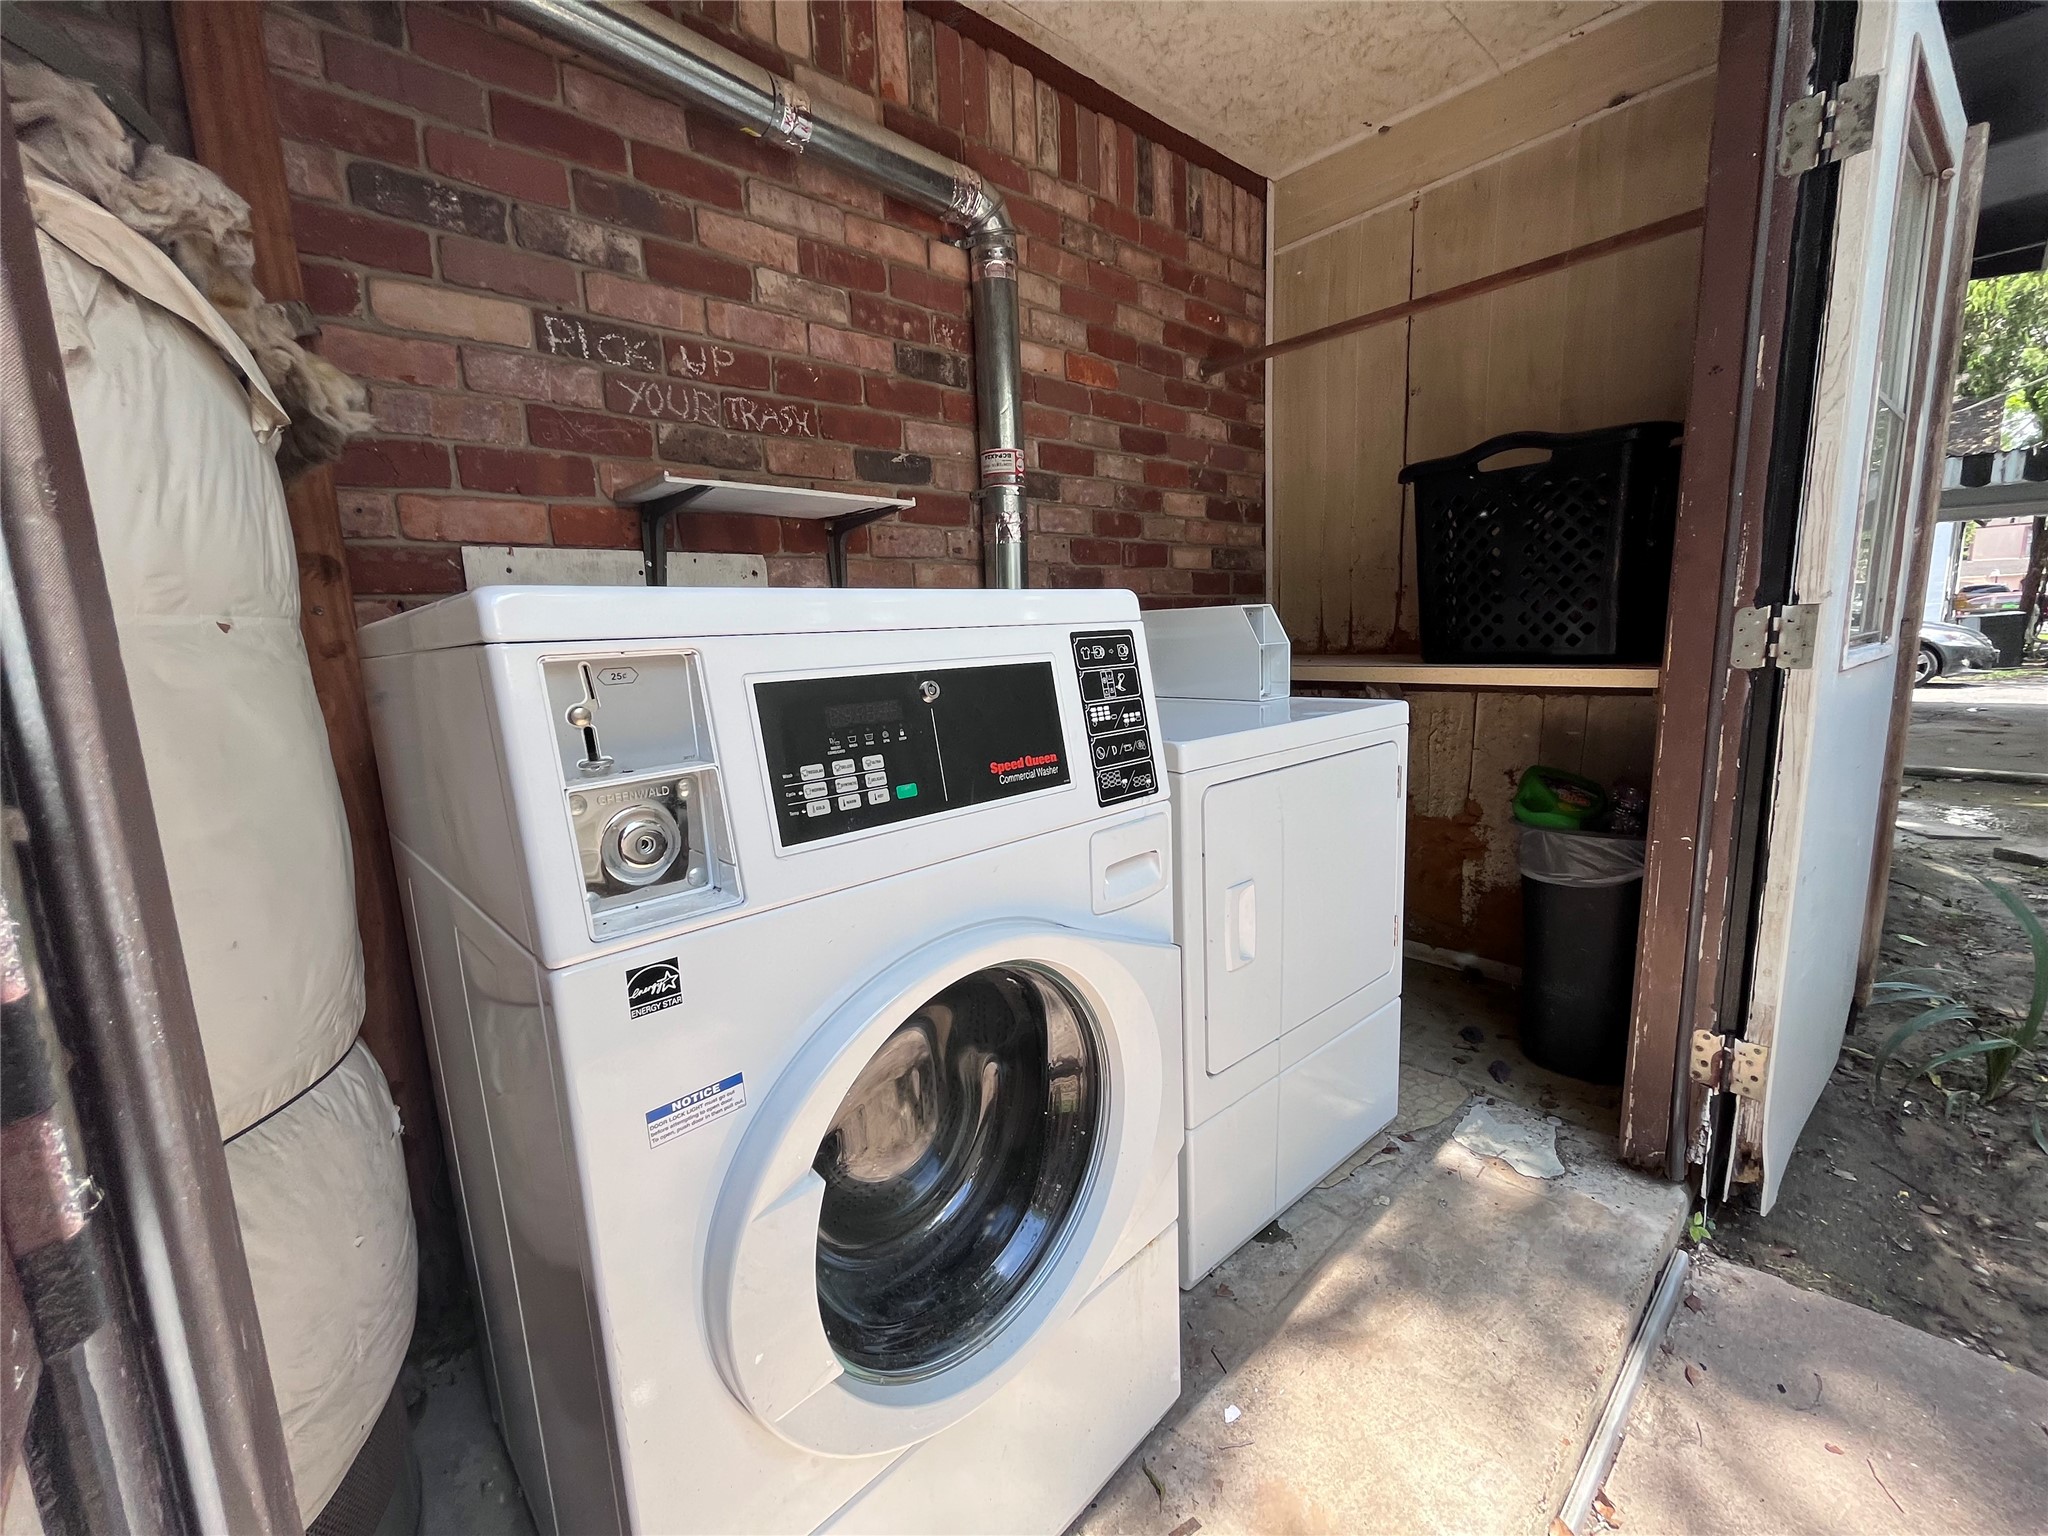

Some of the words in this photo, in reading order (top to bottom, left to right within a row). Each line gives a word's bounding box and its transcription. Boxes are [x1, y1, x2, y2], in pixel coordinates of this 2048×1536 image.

[543, 314, 655, 371] PICK
[679, 345, 736, 376] UP
[616, 380, 721, 427] YOUR
[723, 396, 814, 438] TRASH
[990, 757, 1025, 774] Speed
[1025, 753, 1058, 767] Queen
[999, 769, 1036, 784] Commercial
[1036, 766, 1059, 777] Washer
[597, 785, 670, 806] GREENWALD
[631, 1002, 661, 1018] ENERGY
[662, 996, 682, 1008] STAR
[671, 1083, 721, 1112] NOTICE
[650, 1120, 668, 1131] DOOR
[669, 1111, 686, 1122] LOCK
[687, 1103, 704, 1115] LIGHT
[705, 1098, 718, 1106] must
[651, 1126, 669, 1137] before
[670, 1113, 699, 1129] attempting
[707, 1103, 720, 1112] open
[677, 1123, 690, 1134] push
[692, 1117, 704, 1126] door
[711, 1108, 723, 1117] then
[724, 1103, 734, 1112] pull
